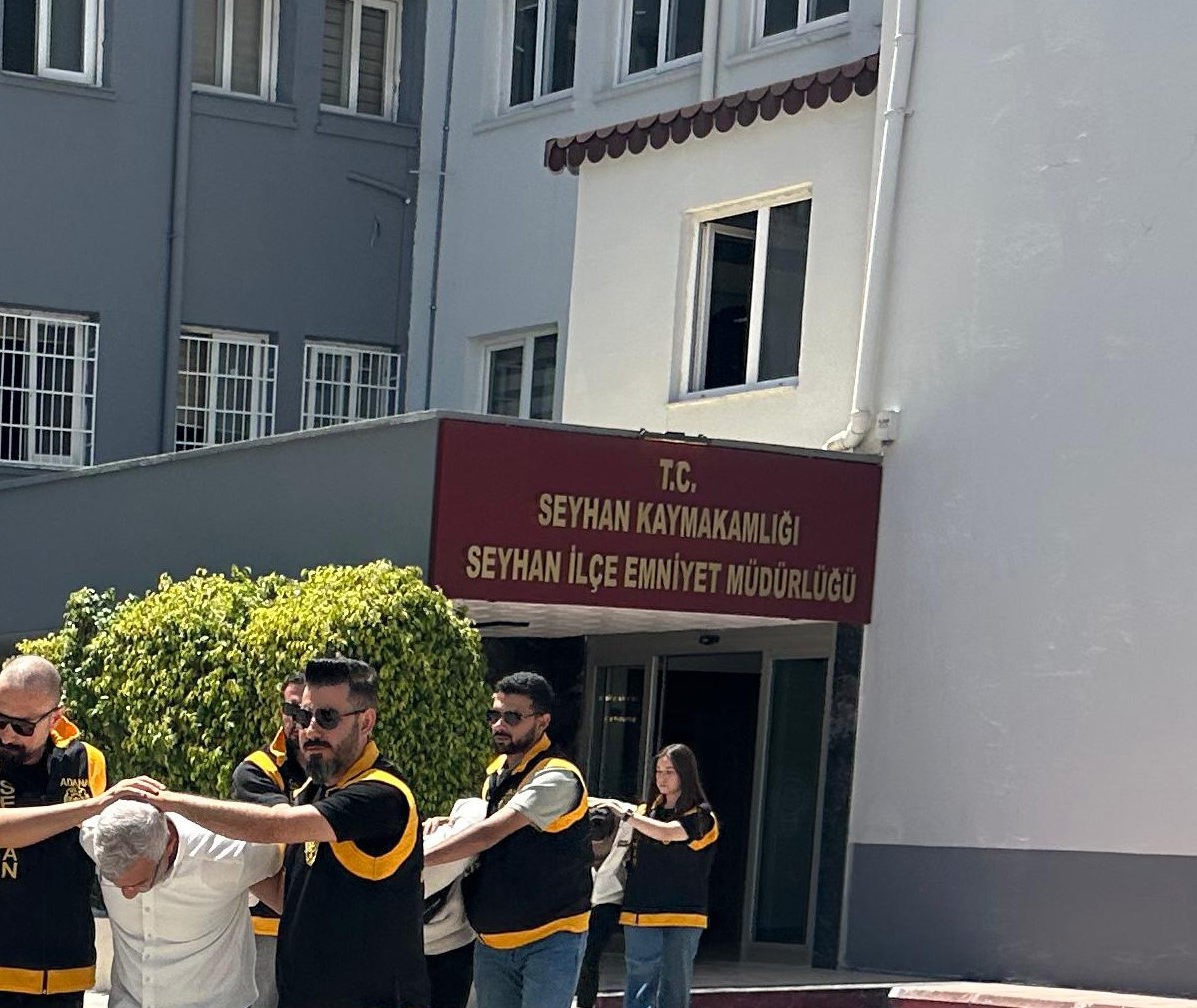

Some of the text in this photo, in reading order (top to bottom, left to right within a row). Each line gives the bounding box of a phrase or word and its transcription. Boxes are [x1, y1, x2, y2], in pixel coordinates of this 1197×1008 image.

[659, 458, 697, 493] T.C.
[538, 493, 800, 546] SEYHAN KAYMAKAMLIĞI
[466, 544, 857, 603] SEYHAN İLÇE EMNİYET MÜDÜRLÜĞÜ
[0, 780, 18, 879] SEAN
